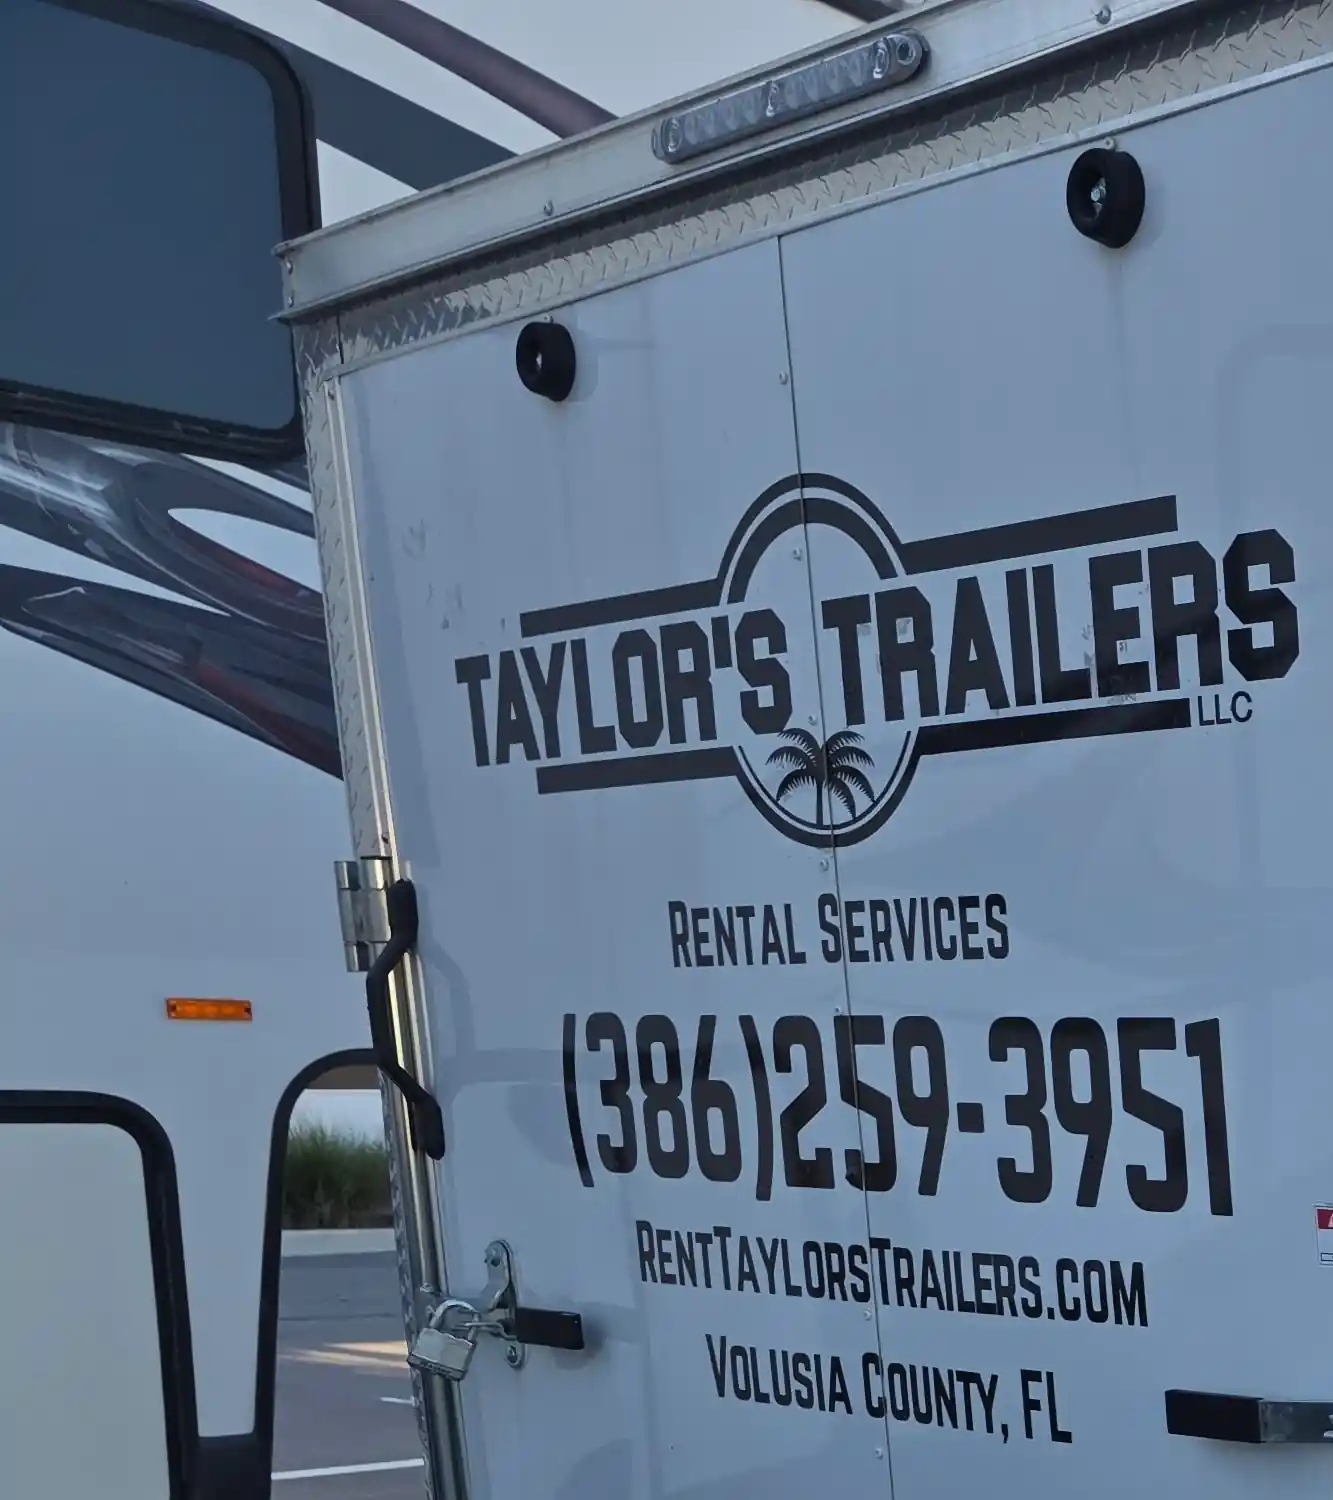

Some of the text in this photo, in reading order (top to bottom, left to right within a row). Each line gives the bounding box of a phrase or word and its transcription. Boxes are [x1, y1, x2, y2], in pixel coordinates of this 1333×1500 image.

[454, 527, 1302, 768] TAYLOR'S TRAILERS
[1196, 690, 1253, 727] LLC
[562, 1011, 1234, 1217] (386)259-3951
[1020, 1368, 1073, 1443] FL
